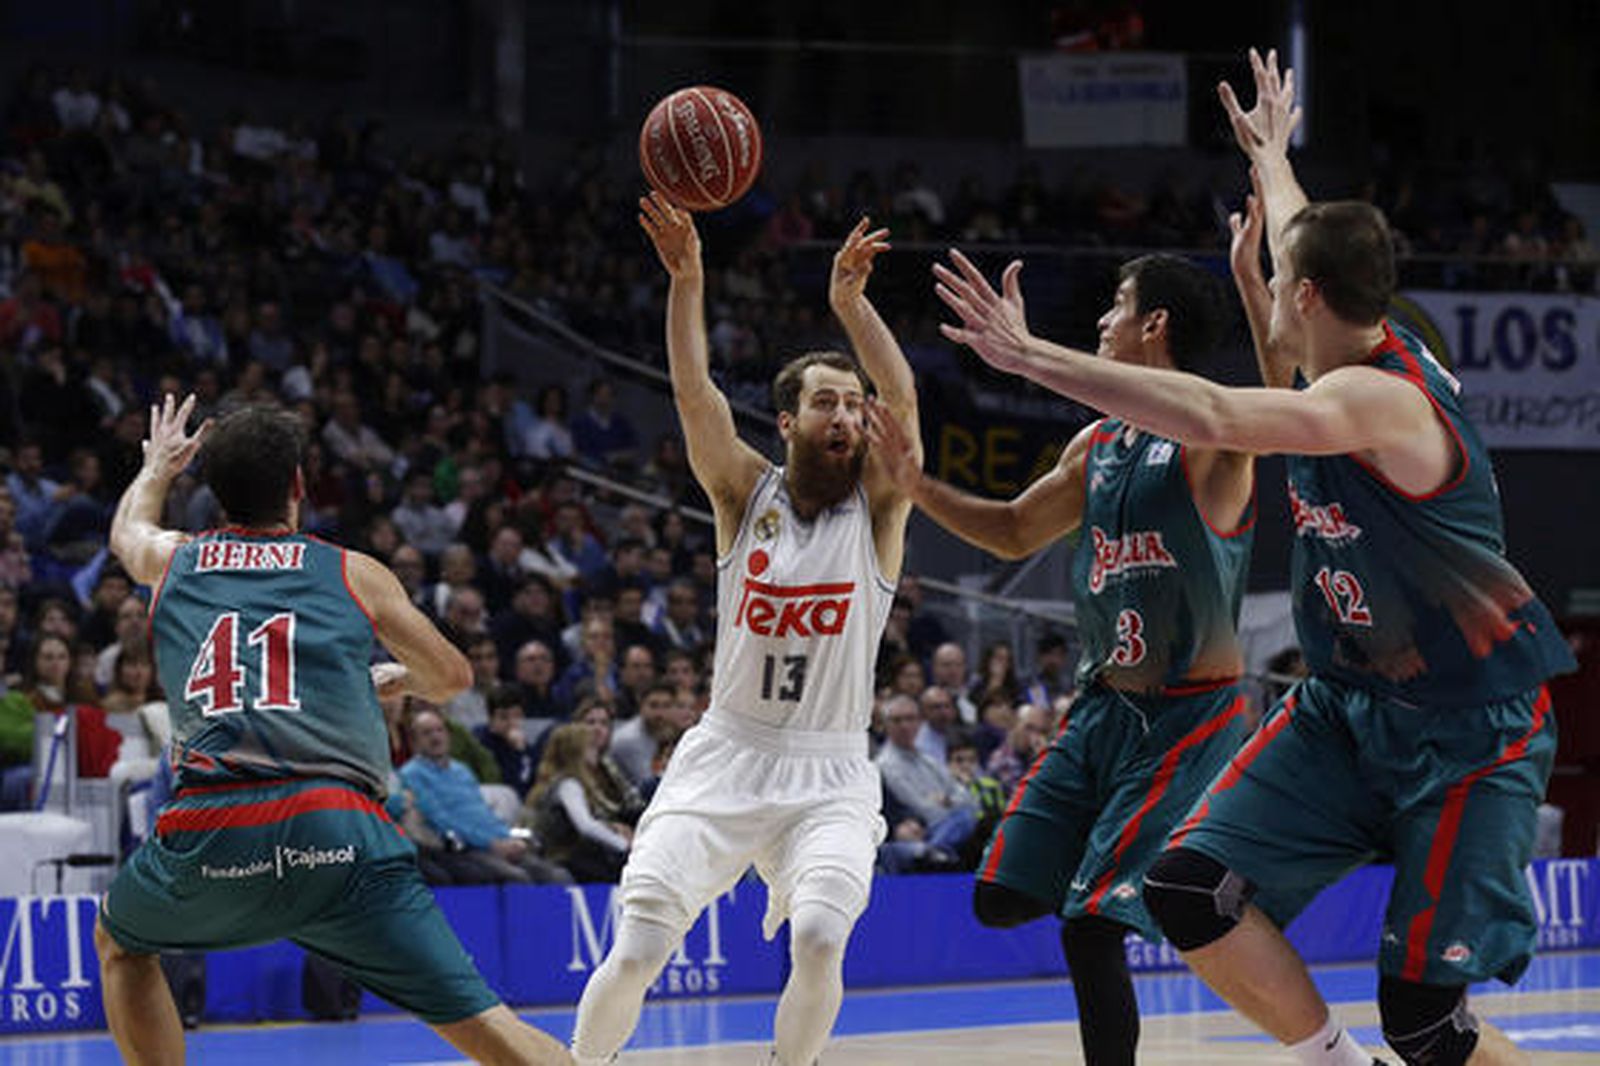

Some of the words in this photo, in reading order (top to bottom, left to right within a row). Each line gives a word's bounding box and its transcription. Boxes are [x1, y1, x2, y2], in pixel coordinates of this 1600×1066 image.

[1454, 305, 1578, 373] LOS
[1462, 392, 1600, 431] EUROP
[195, 542, 305, 573] BERNI
[1315, 566, 1372, 626] 12
[1112, 609, 1145, 666] 3
[184, 611, 300, 718] 41
[761, 653, 808, 703] 13
[287, 845, 356, 870] Cajasol
[652, 967, 721, 993] ROS
[0, 991, 81, 1022] ROS
